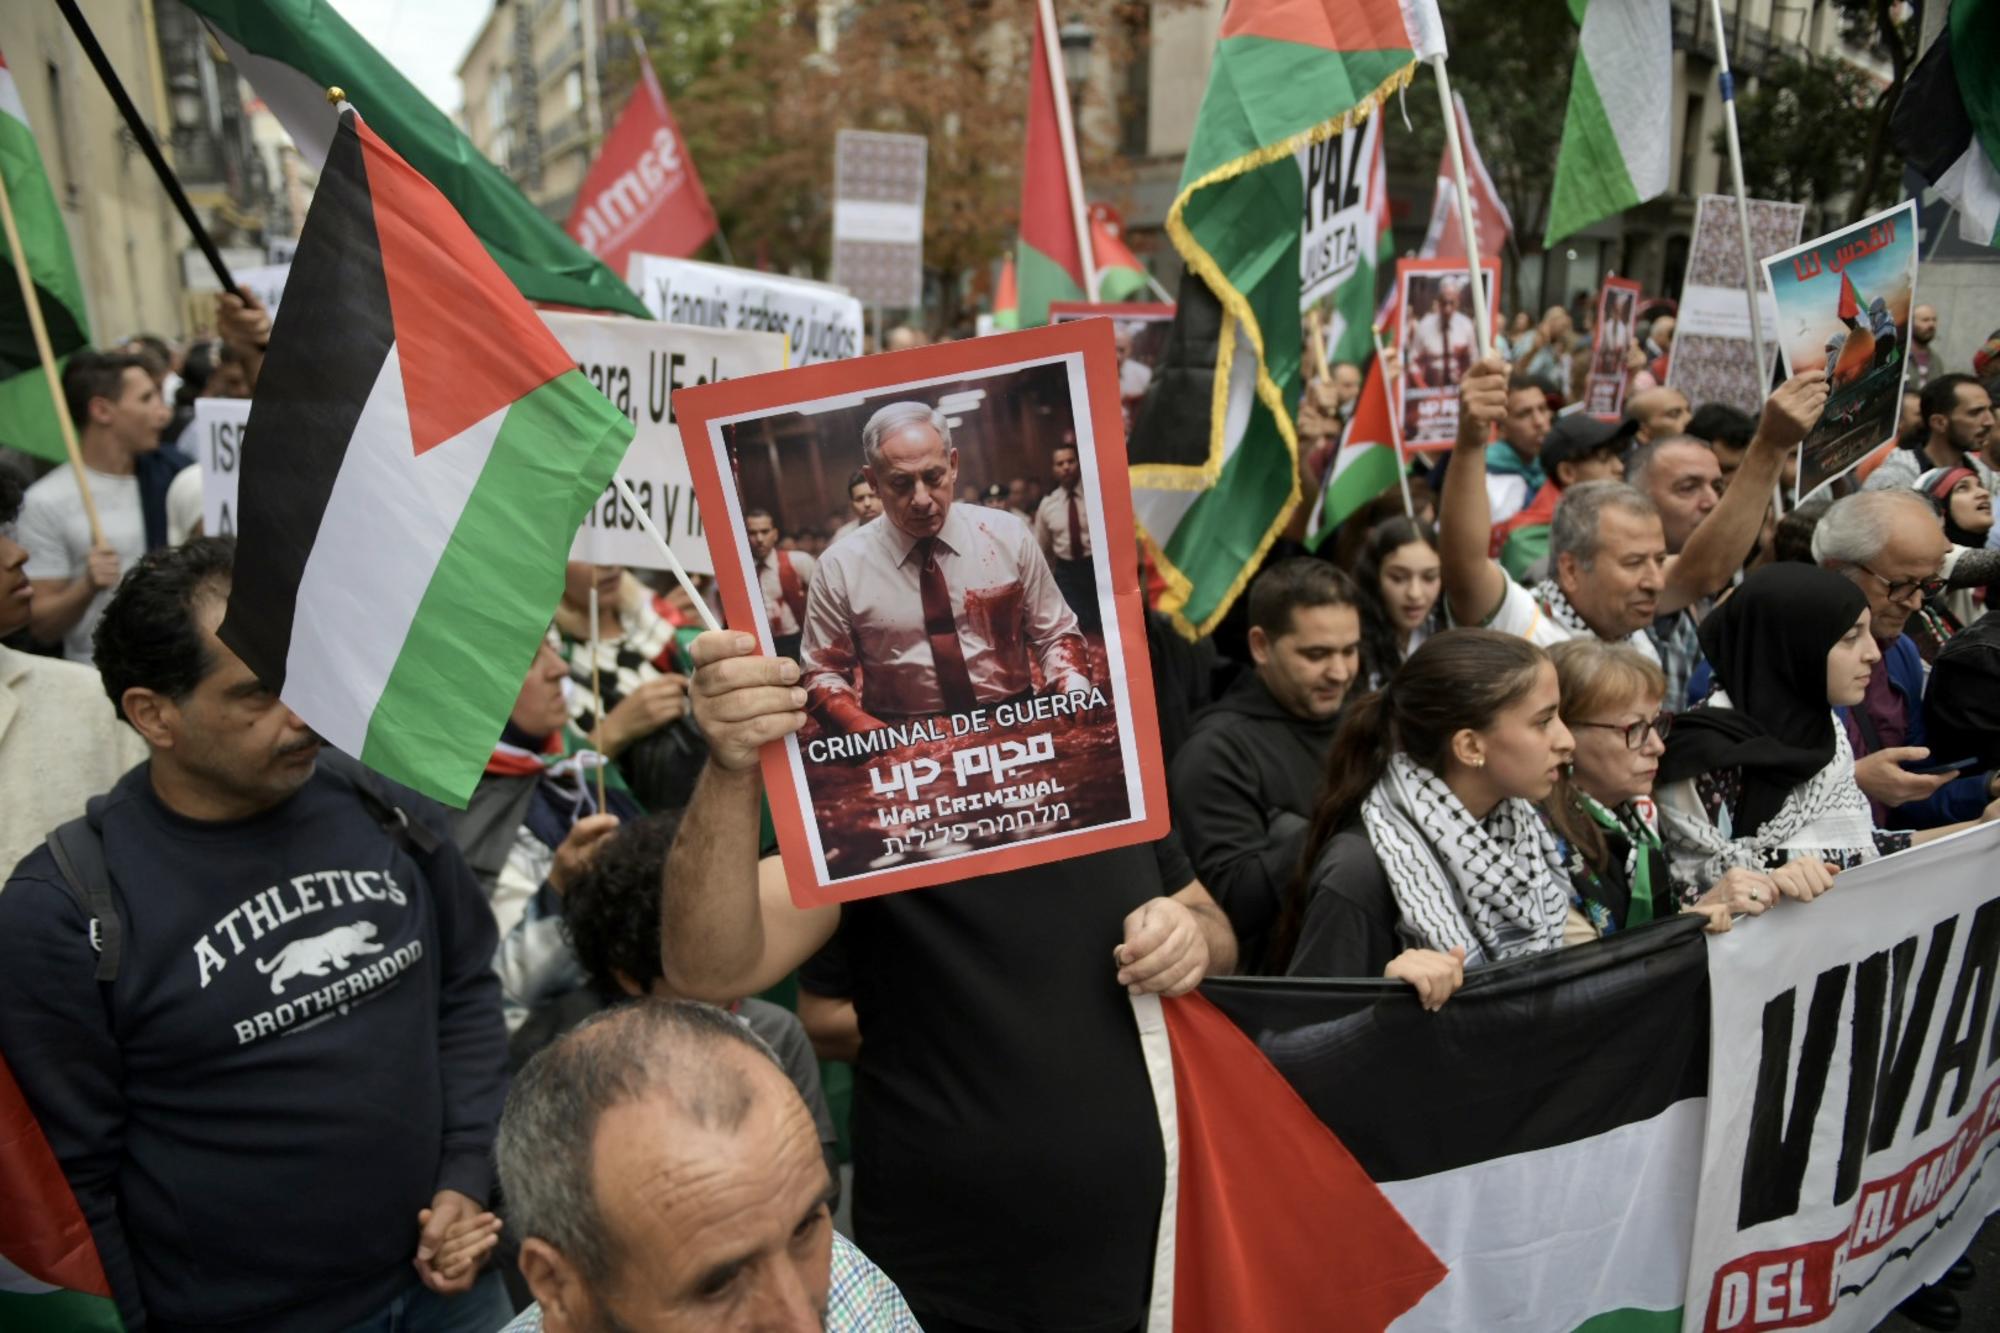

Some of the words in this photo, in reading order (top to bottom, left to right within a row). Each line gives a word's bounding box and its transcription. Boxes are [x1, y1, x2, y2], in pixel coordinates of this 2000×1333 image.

[1306, 118, 1367, 233] PAZ
[1793, 250, 1823, 282] لنا
[1828, 218, 1895, 273] القدس
[791, 314, 804, 353] o
[808, 718, 945, 763] CRIMINAL
[952, 709, 990, 735] DE
[994, 686, 1107, 727] GUERRA
[882, 822, 970, 857] פלילית
[976, 801, 1071, 838] מלחמה
[193, 869, 407, 989] ATHLETICS
[233, 939, 423, 1045] BROTHERHOOD
[1716, 1258, 1814, 1331] DEL
[1852, 1182, 1901, 1250] AL
